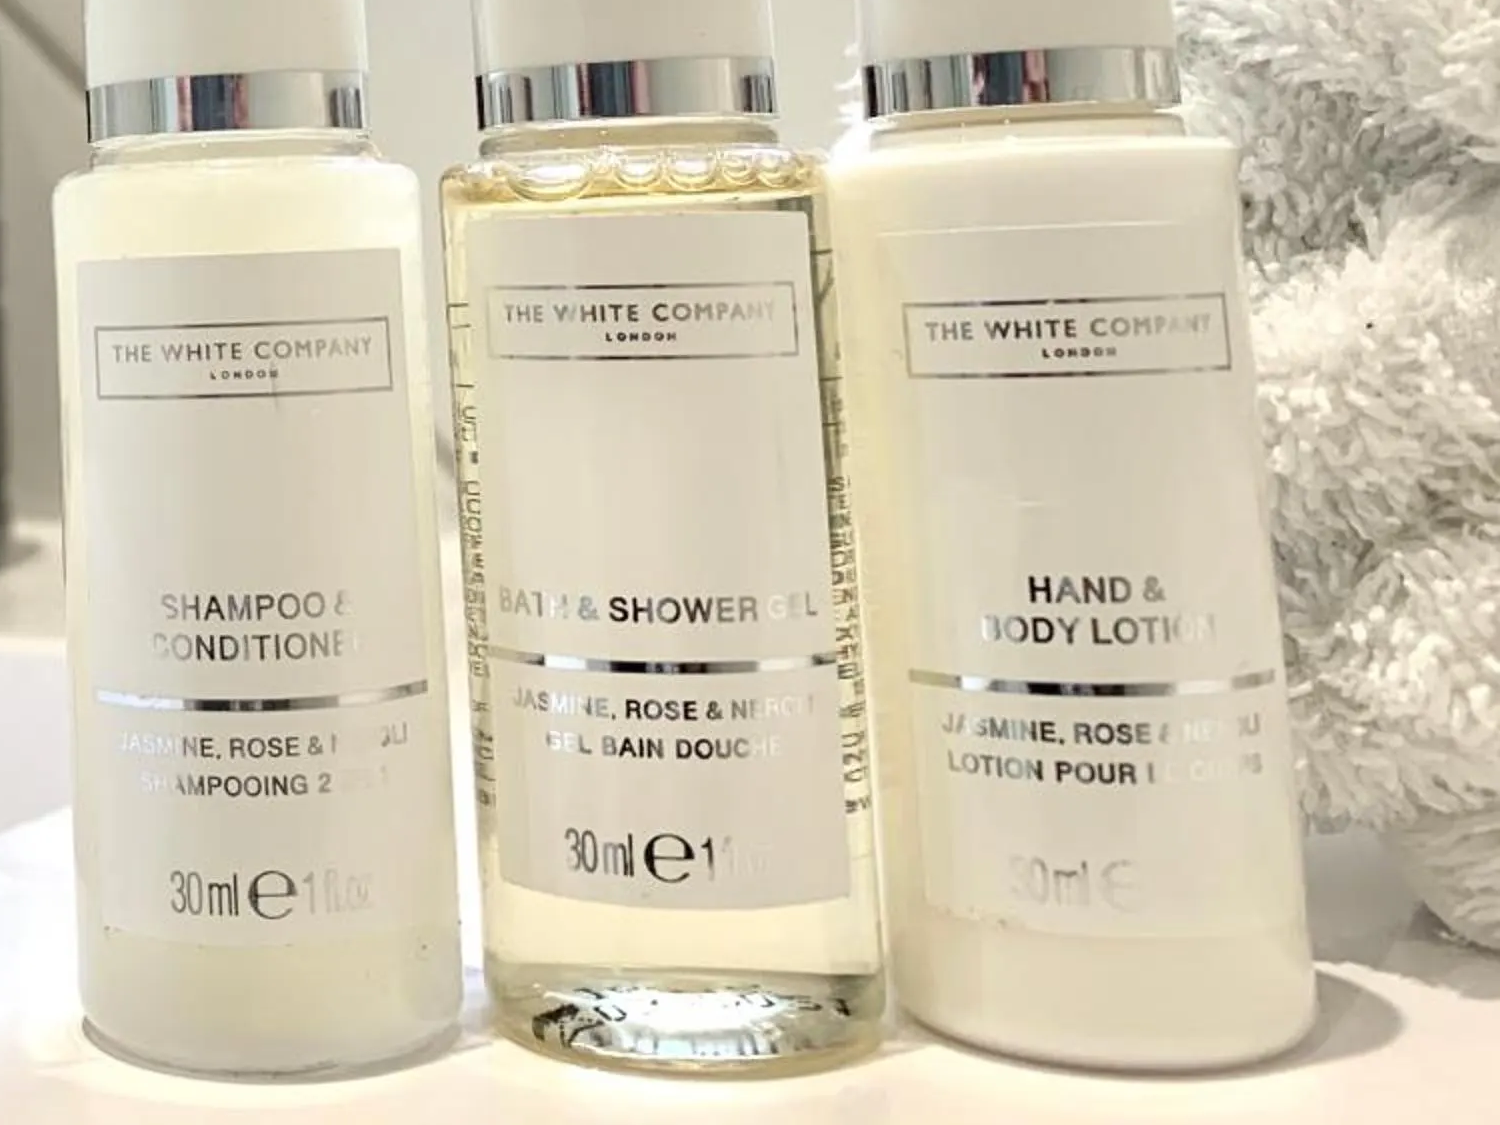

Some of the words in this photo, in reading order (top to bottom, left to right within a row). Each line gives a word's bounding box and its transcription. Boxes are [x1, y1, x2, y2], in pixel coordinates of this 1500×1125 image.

[503, 303, 545, 325] THE
[553, 302, 640, 324] WHITE
[651, 298, 776, 322] COMPANY
[605, 331, 678, 343] LONDON
[925, 320, 975, 342] THE
[984, 317, 1078, 341] WHITE
[1089, 313, 1212, 338] COMPANY
[111, 343, 152, 364] THE
[161, 341, 243, 362] WHITE
[254, 335, 373, 361] COMPANY
[1041, 346, 1118, 359] LONDON
[209, 368, 279, 381] LONDON
[1028, 574, 1133, 605] HAND
[1143, 575, 1167, 603] &
[160, 590, 326, 622] SHAMPOO
[499, 586, 569, 620] BATH
[578, 595, 600, 621] &
[608, 594, 759, 624] SHOWER
[767, 591, 819, 619] GEL
[625, 698, 699, 722] ROSE
[705, 699, 725, 721] &
[229, 735, 301, 758] ROSE
[307, 736, 324, 756] &
[546, 730, 593, 756] GEL
[601, 734, 666, 760] BAIN
[674, 734, 782, 761] DOUCHE
[1073, 720, 1153, 747] ROSE
[946, 748, 1045, 782] LOTION
[1055, 760, 1138, 786] POUR
[317, 773, 333, 794] 2
[563, 827, 635, 878] 30ml
[169, 869, 240, 918] 30ml
